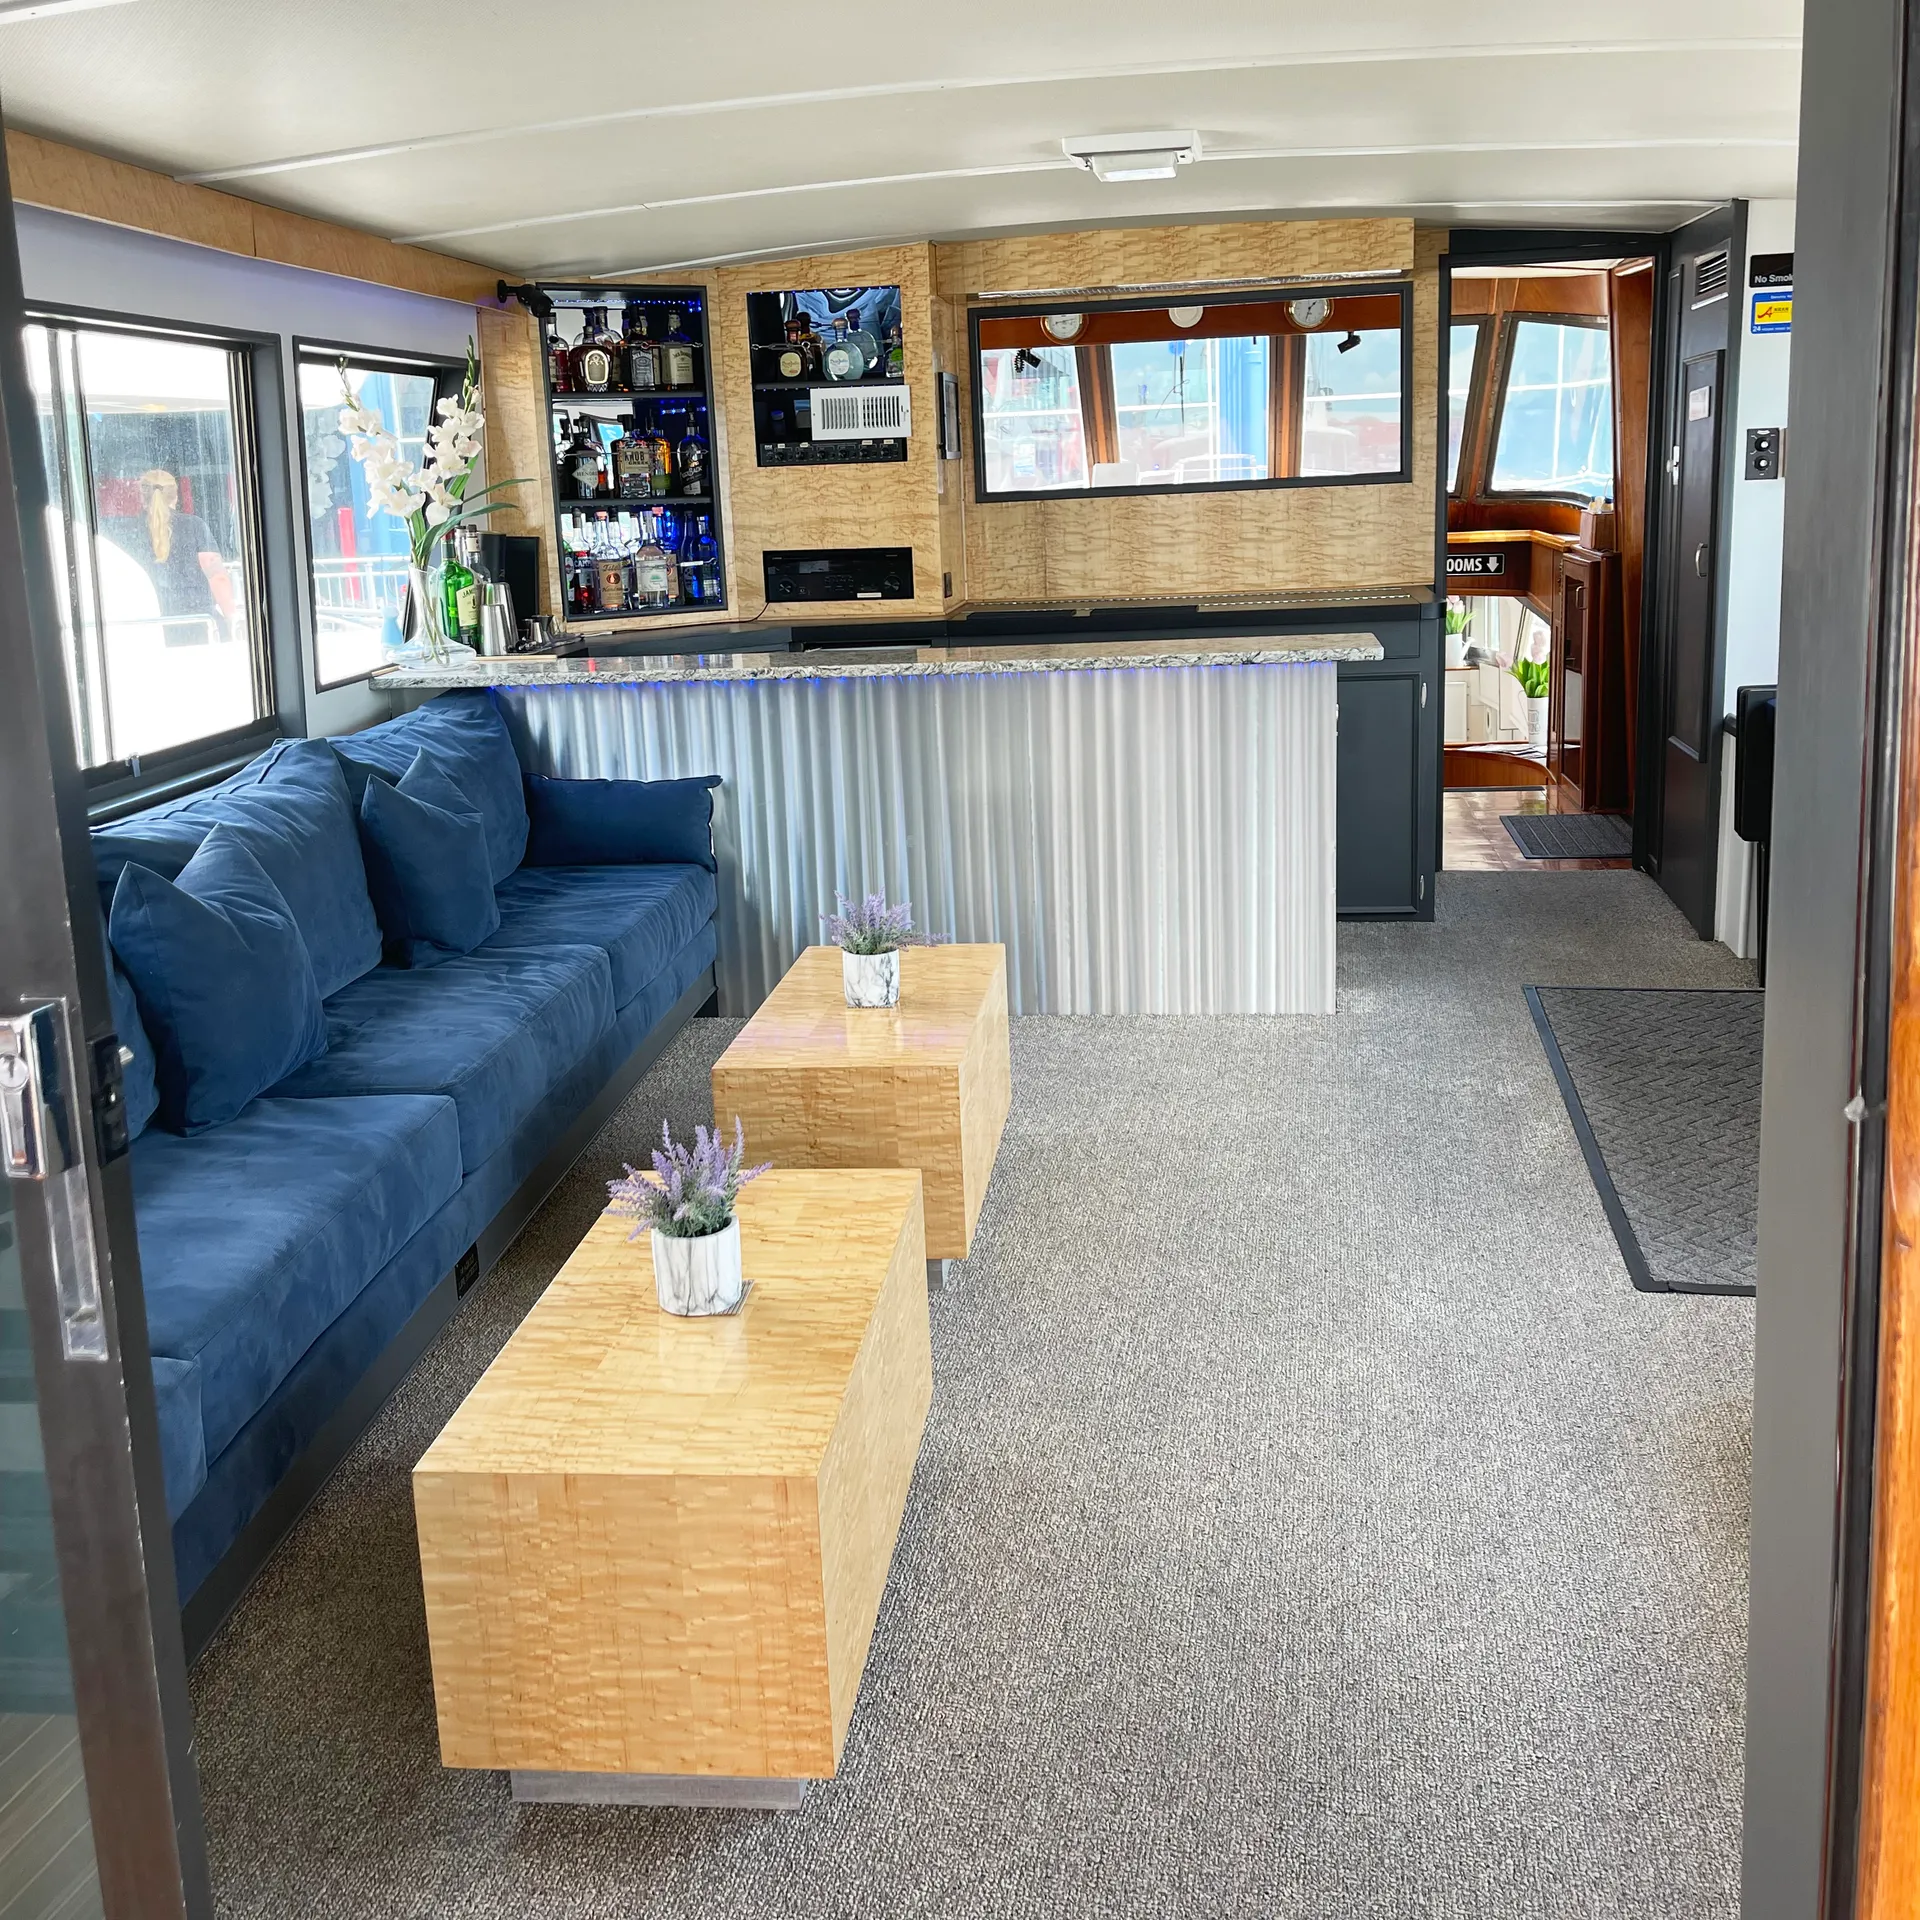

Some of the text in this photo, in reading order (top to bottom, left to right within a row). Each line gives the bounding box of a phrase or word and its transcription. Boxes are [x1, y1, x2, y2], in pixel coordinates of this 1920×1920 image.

[1755, 274, 1793, 283] No Smok
[1447, 558, 1482, 571] OOMS
